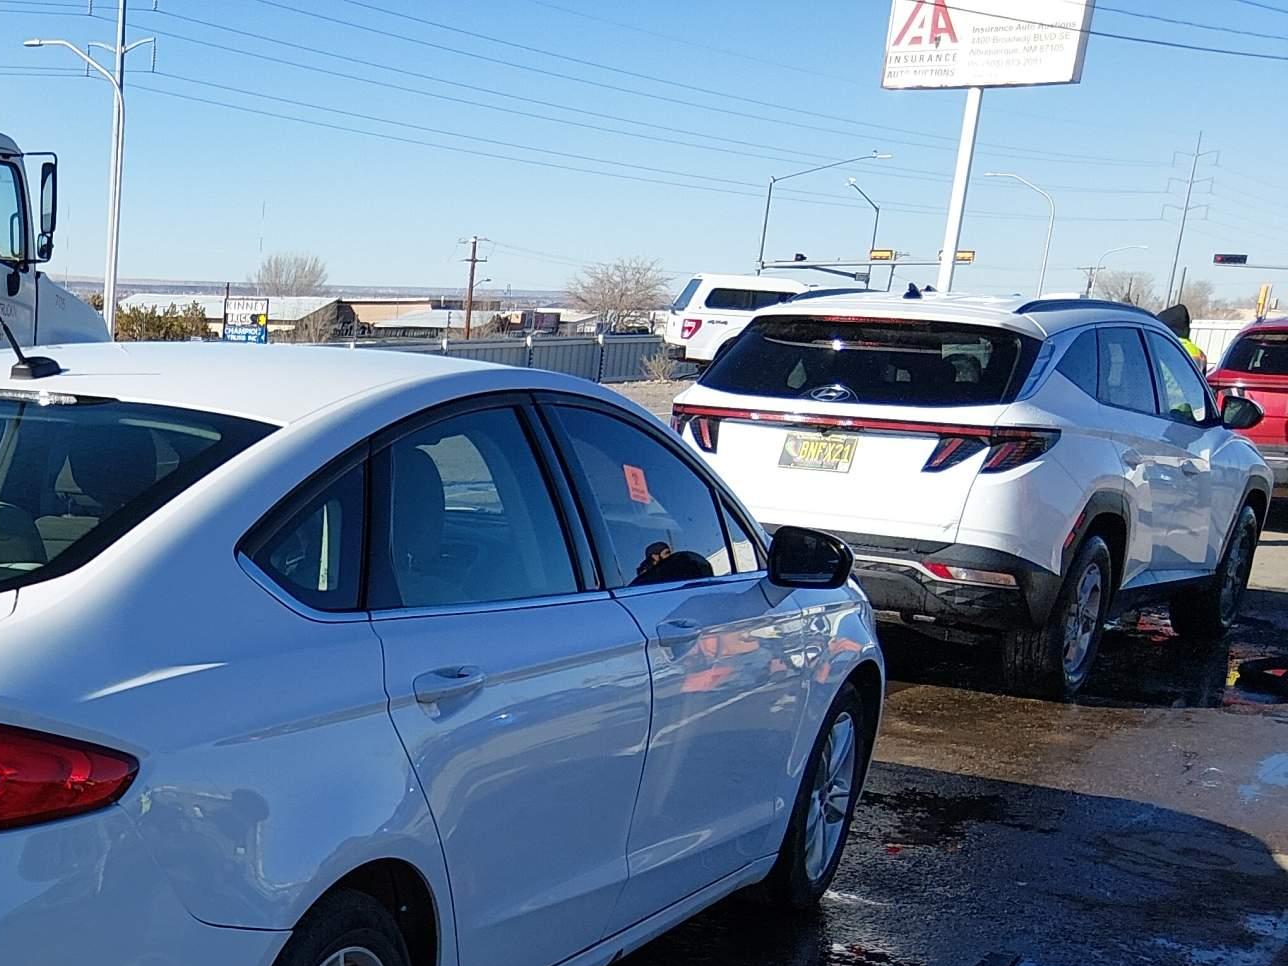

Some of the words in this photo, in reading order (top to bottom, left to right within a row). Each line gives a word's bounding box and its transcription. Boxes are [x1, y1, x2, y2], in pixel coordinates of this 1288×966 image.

[972, 25, 1014, 33] Insurance
[1015, 23, 1035, 31] Auto
[1033, 33, 1057, 41] BLVD
[1058, 32, 1071, 40] SE
[1023, 45, 1038, 53] NM
[888, 53, 958, 65] INSURANCE
[226, 301, 265, 311] KINNEY
